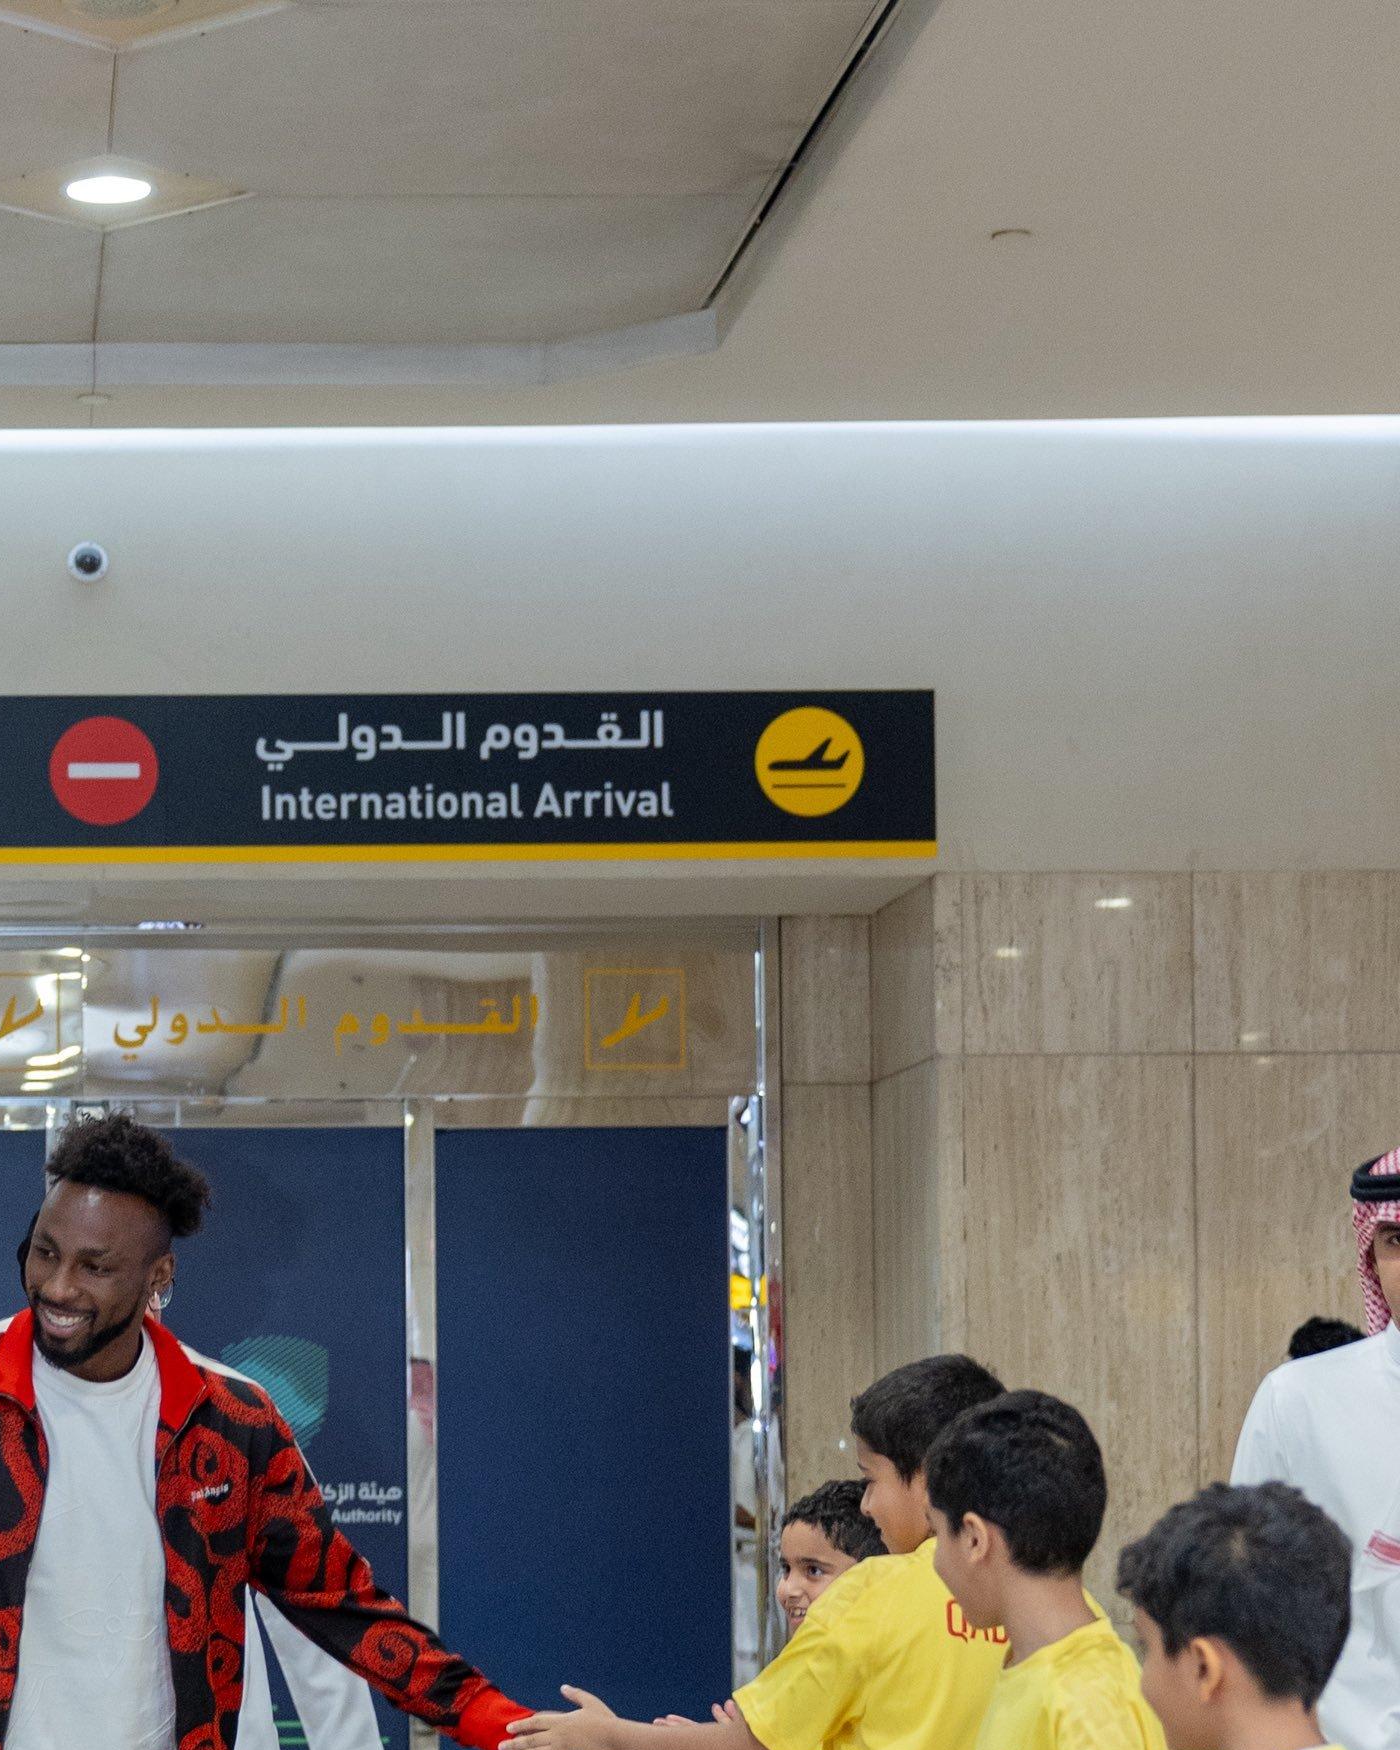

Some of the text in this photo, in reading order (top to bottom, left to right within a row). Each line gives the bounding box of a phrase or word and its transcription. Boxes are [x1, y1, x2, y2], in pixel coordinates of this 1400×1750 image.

[255, 709, 664, 771] القدوم الدولي
[261, 781, 674, 820] International Arrival
[113, 994, 538, 1061] القدوم الدولي
[331, 1508, 402, 1525] Authority
